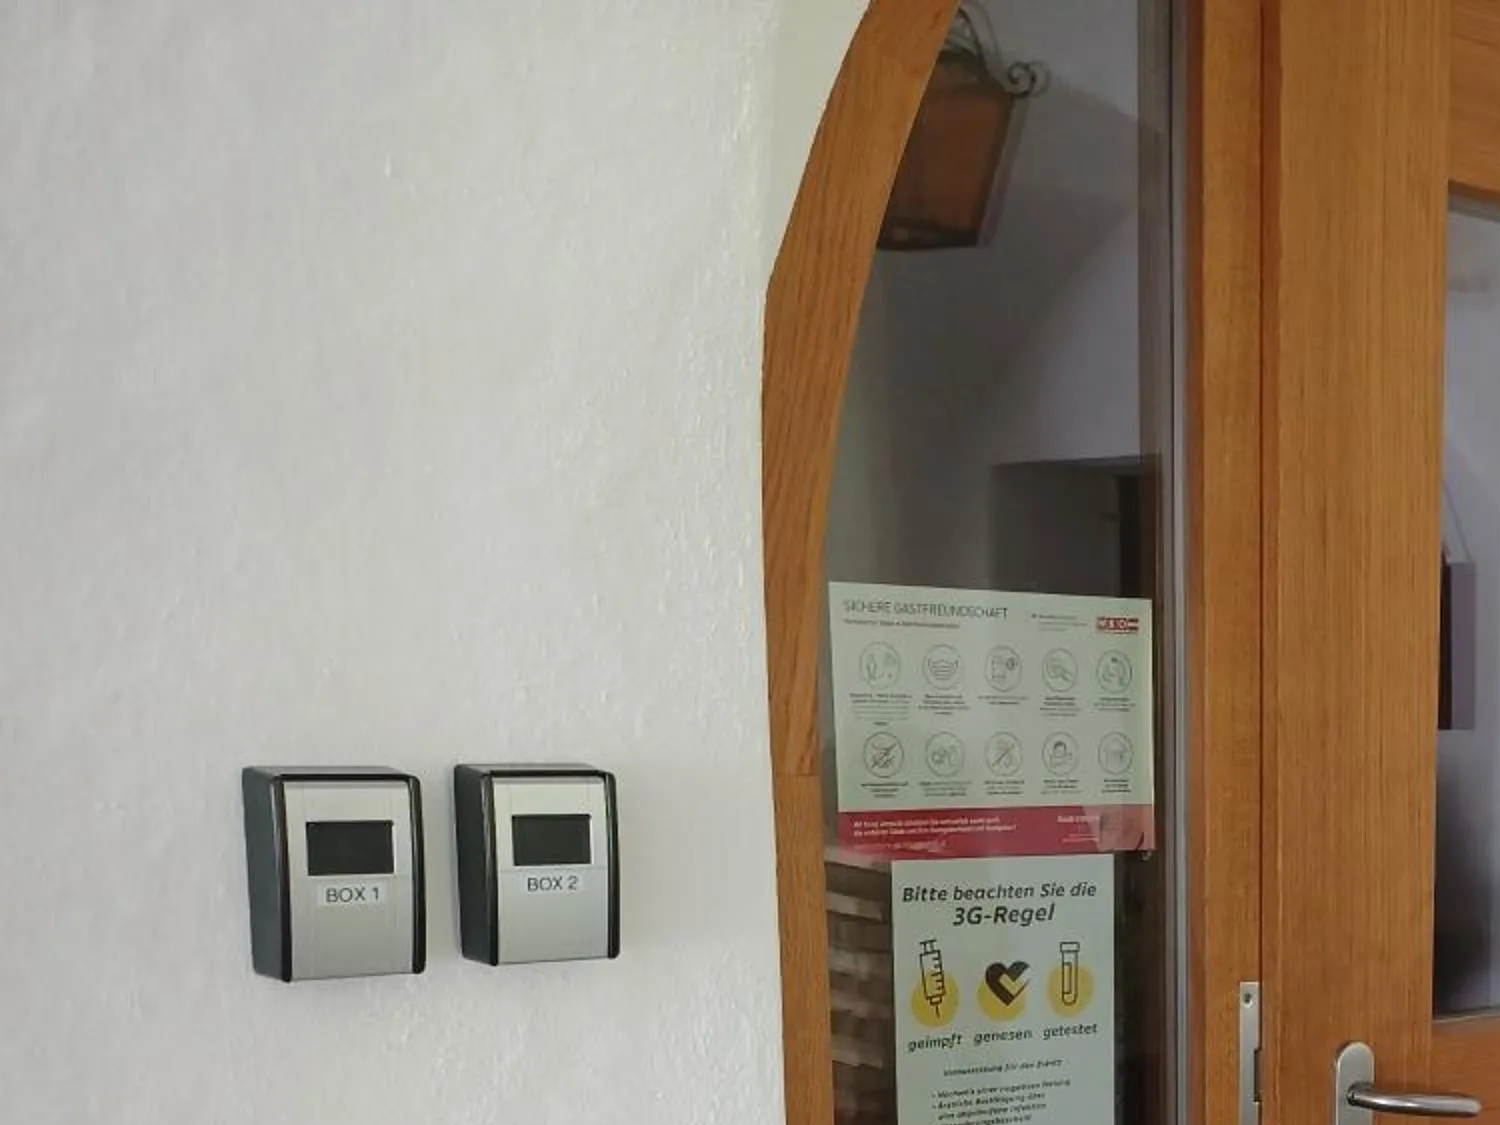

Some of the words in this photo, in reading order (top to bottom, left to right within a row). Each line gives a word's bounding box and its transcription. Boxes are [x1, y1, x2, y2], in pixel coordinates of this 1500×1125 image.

[326, 885, 366, 903] BOX
[371, 886, 379, 901] 1
[527, 875, 563, 892] BOX
[567, 875, 578, 891] 2
[902, 886, 948, 902] Bitte
[953, 885, 1035, 901] beachten
[1040, 883, 1065, 898] Sie
[1069, 881, 1097, 897] die
[952, 903, 1055, 927] 3G-Regel
[907, 1032, 963, 1052] geimpft
[973, 1027, 1033, 1046] genesen
[1042, 1022, 1098, 1041] getestet
